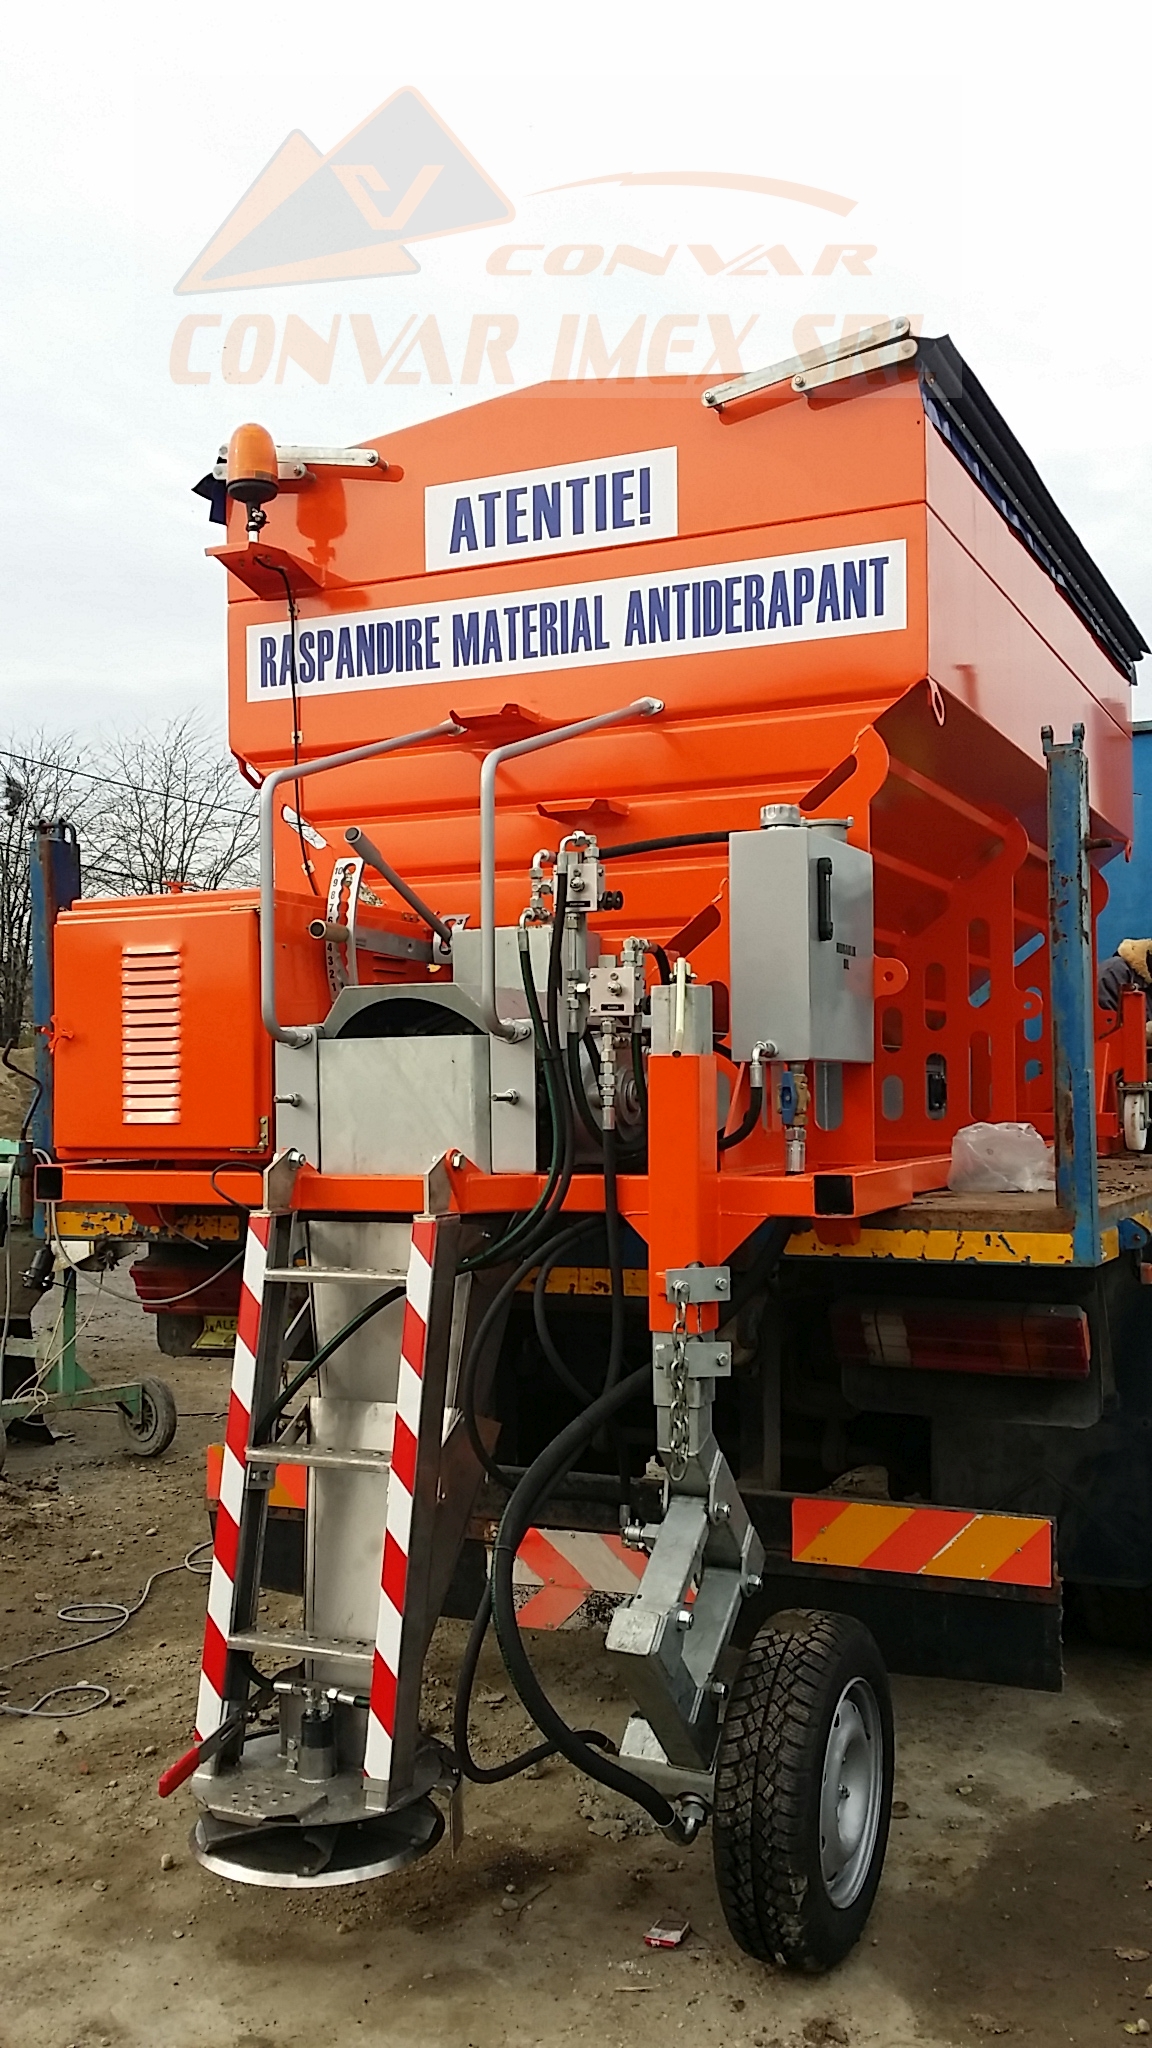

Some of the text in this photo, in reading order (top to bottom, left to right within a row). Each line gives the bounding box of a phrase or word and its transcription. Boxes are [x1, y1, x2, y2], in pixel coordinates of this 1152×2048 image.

[449, 466, 651, 554] ATENTIE!
[260, 556, 890, 688] RASPANDIRE MATERIAL ANTIDERAPANT
[334, 866, 344, 875] 10
[332, 878, 339, 887] 9
[330, 891, 336, 900] 8
[329, 904, 335, 913] 7
[327, 943, 333, 952] 4
[327, 956, 334, 966] 3
[329, 970, 335, 979] 2
[331, 982, 337, 992] 1
